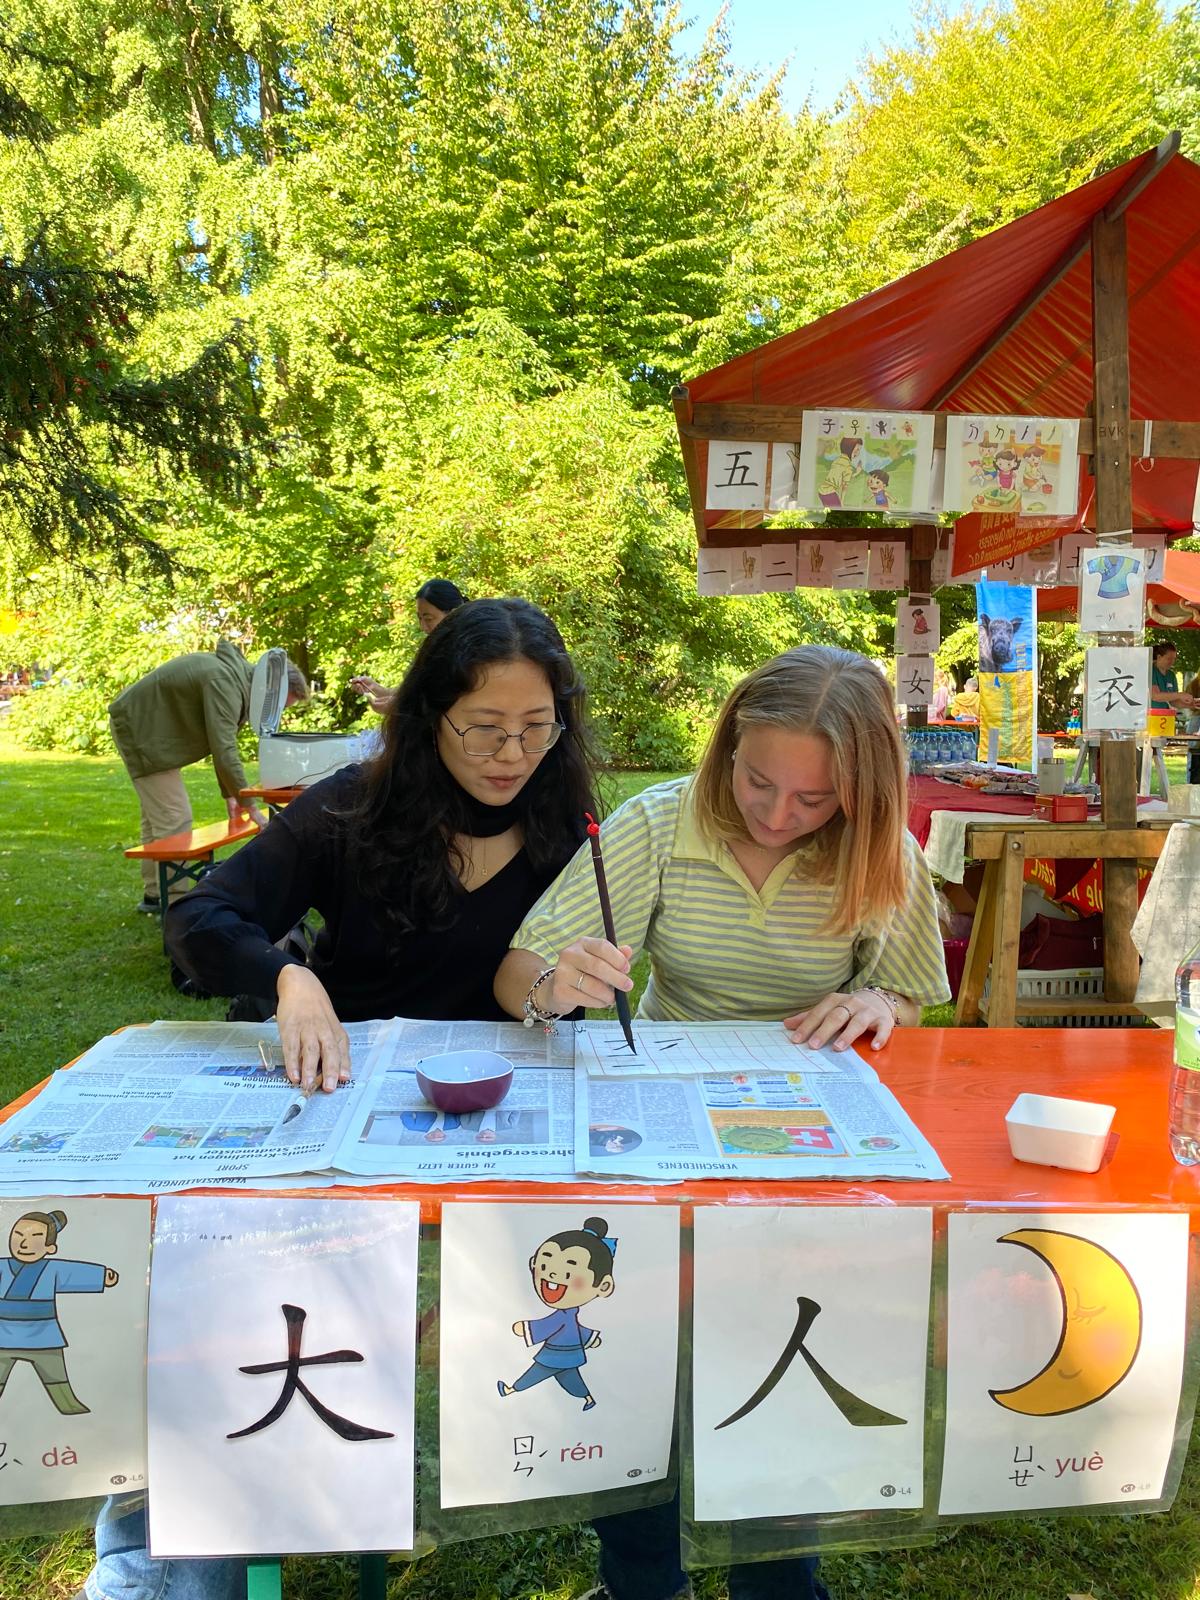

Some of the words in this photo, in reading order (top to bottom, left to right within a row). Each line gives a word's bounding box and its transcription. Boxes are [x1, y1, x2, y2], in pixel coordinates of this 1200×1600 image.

[822, 418, 836, 434] 子
[714, 450, 759, 488] 五
[765, 560, 793, 578] 二
[837, 555, 865, 578] 三
[901, 669, 931, 695] 女
[1094, 666, 1142, 712] 衣
[198, 1147, 322, 1160] Tennis-Kreuzlingen
[204, 1146, 290, 1155] Stadtmeister
[216, 1163, 250, 1171] SPORT
[657, 1161, 738, 1170] VERSCHIEDENES
[147, 1177, 248, 1188] VERANSTALTUNGEN
[225, 1303, 396, 1442] 大
[713, 1296, 908, 1431] 人
[41, 1445, 78, 1467] dà
[560, 1441, 603, 1463] rén
[1054, 1451, 1104, 1479] yuè
